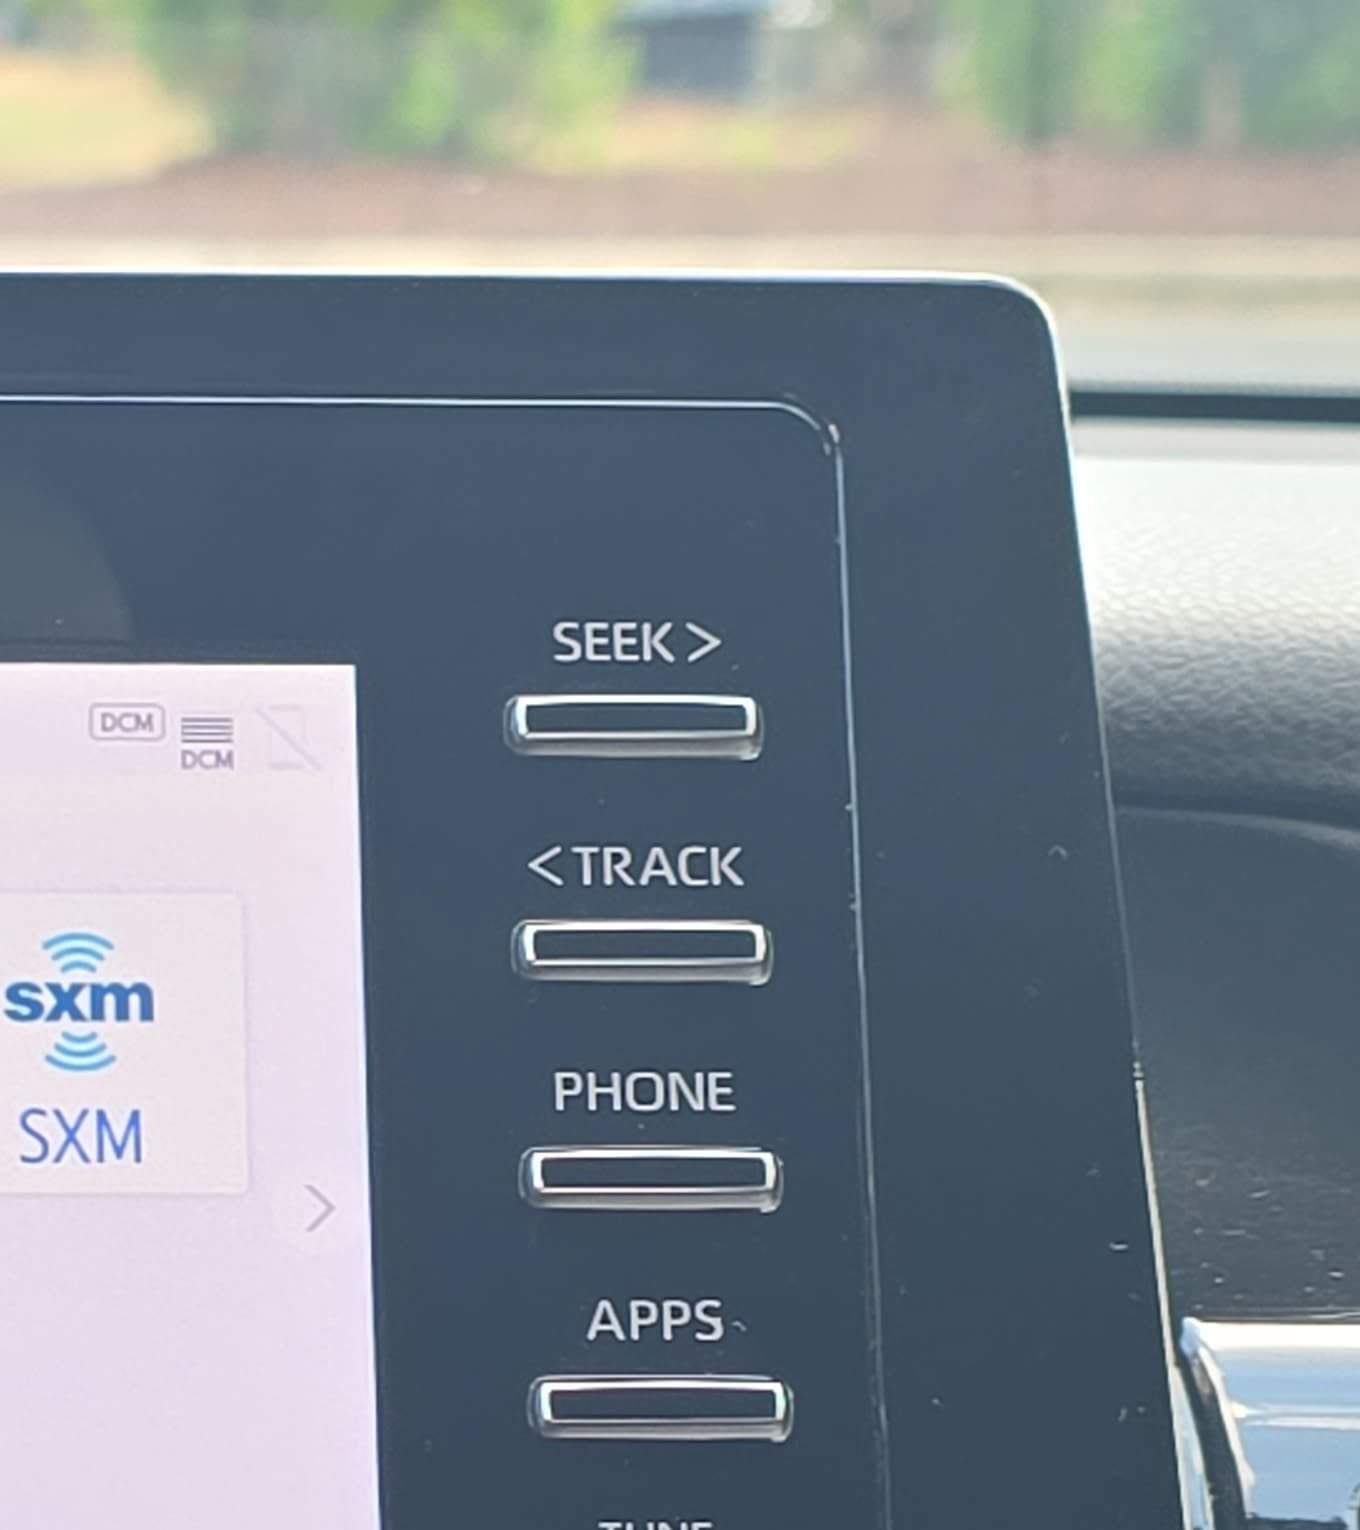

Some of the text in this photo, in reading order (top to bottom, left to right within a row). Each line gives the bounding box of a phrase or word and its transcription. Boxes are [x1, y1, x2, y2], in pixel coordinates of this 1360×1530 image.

[100, 713, 153, 733] DCM
[181, 750, 234, 771] DCM
[2, 978, 156, 1024] sxm
[554, 1071, 736, 1112] PHONE
[17, 1108, 144, 1166] SXM
[586, 1299, 725, 1341] APPS
